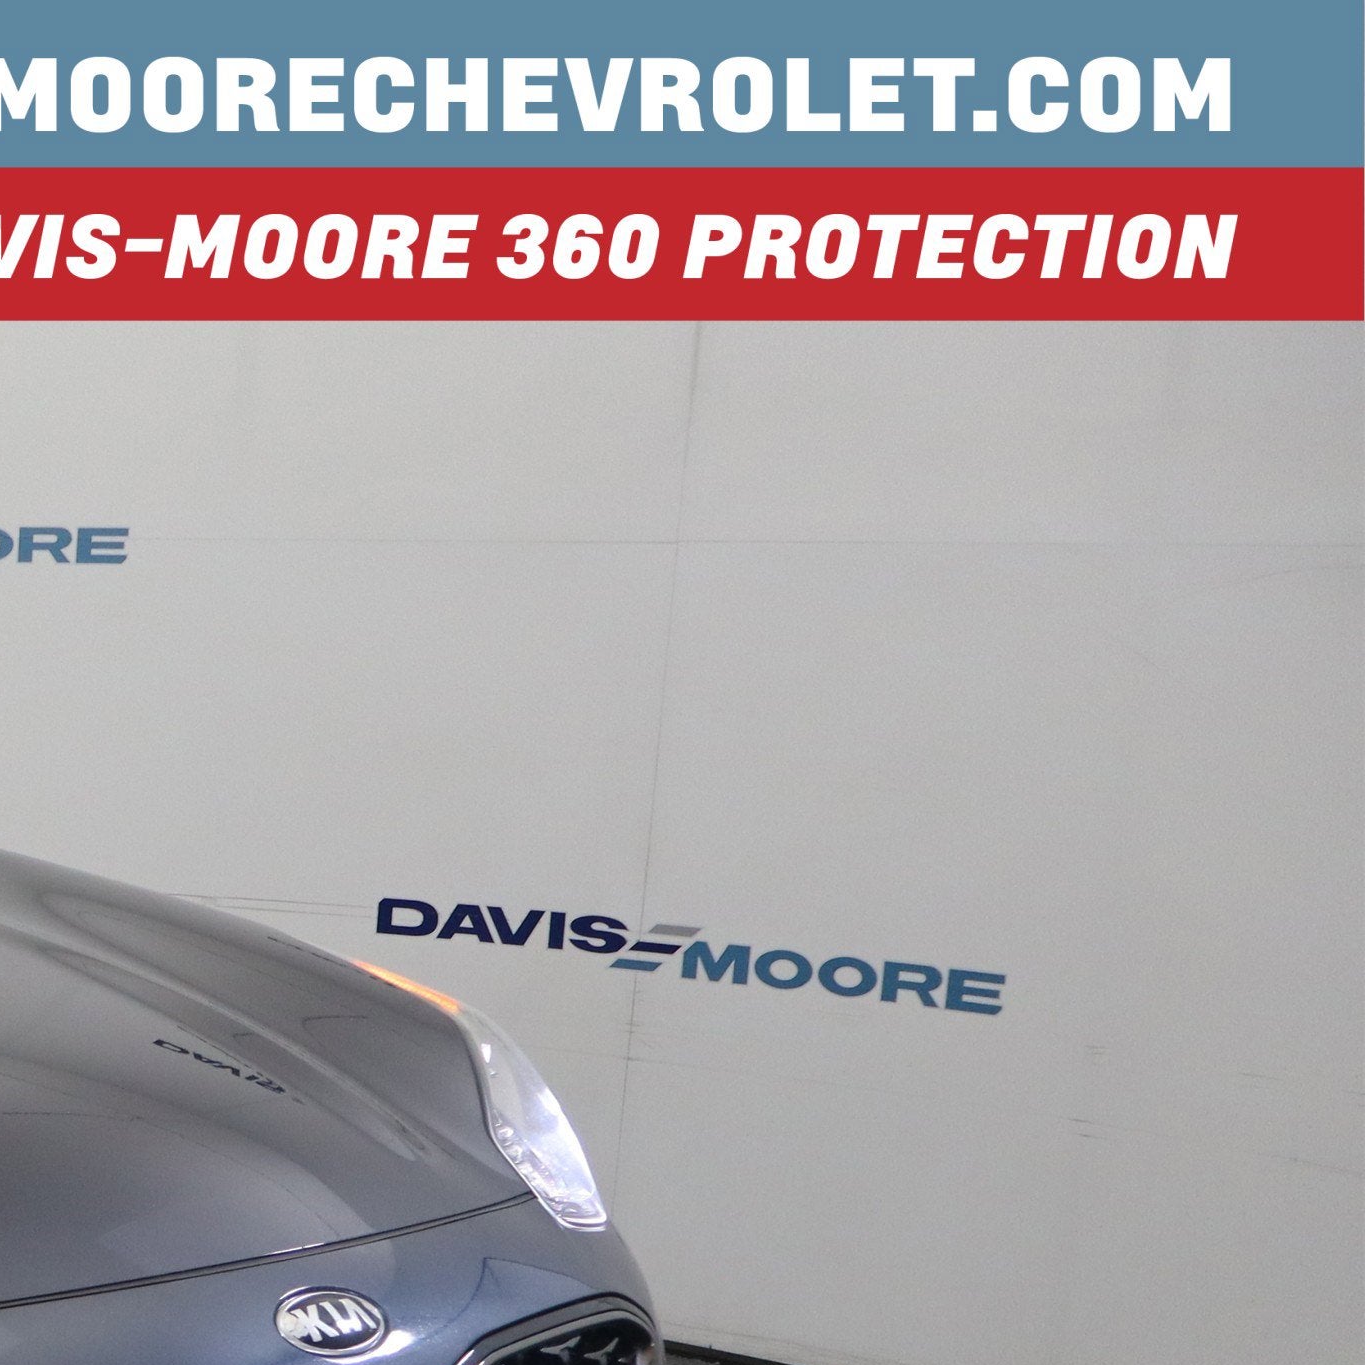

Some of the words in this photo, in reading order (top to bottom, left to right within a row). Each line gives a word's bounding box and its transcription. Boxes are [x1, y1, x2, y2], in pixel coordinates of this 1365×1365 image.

[375, 897, 629, 955] DAVIS
[680, 940, 1006, 1016] MOORE
[288, 1298, 377, 1344] KIA
